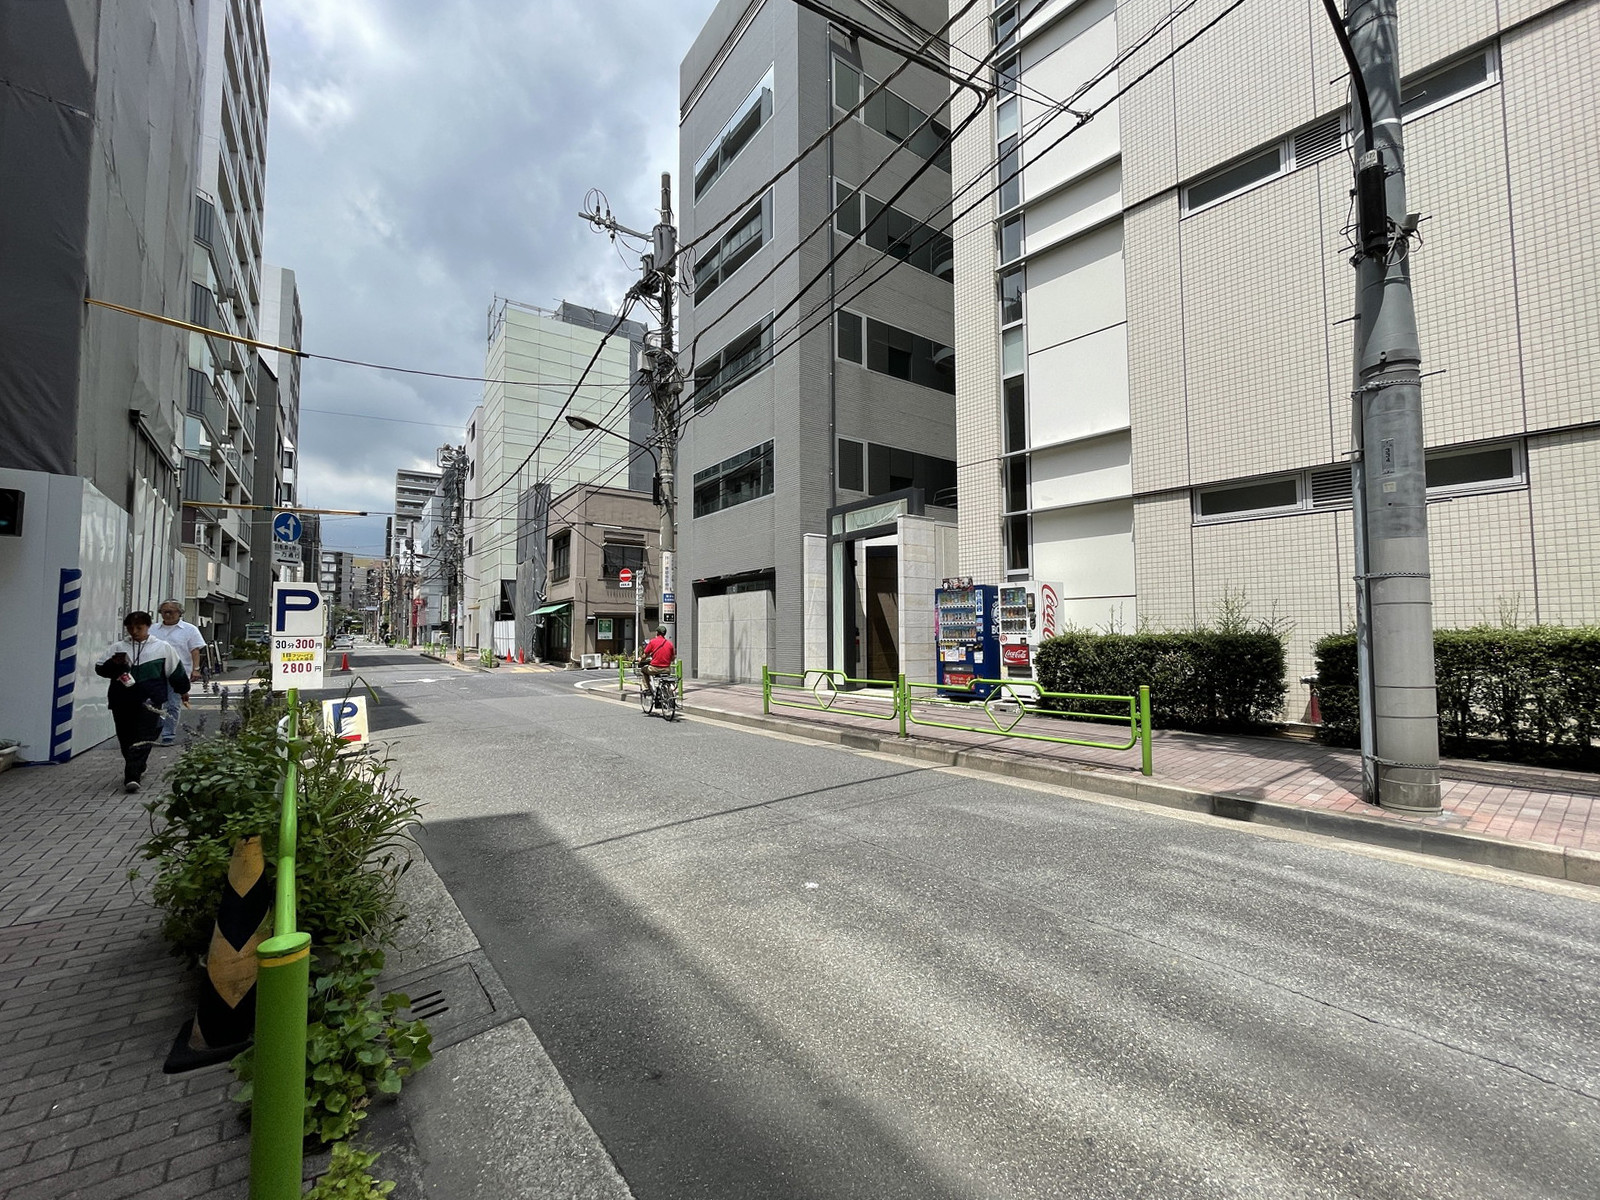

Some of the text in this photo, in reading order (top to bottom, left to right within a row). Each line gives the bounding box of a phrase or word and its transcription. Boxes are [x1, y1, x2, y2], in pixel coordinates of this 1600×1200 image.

[275, 551, 300, 559] 一方通行
[276, 588, 319, 631] P
[282, 662, 322, 673] 2800円
[332, 702, 358, 734] P
